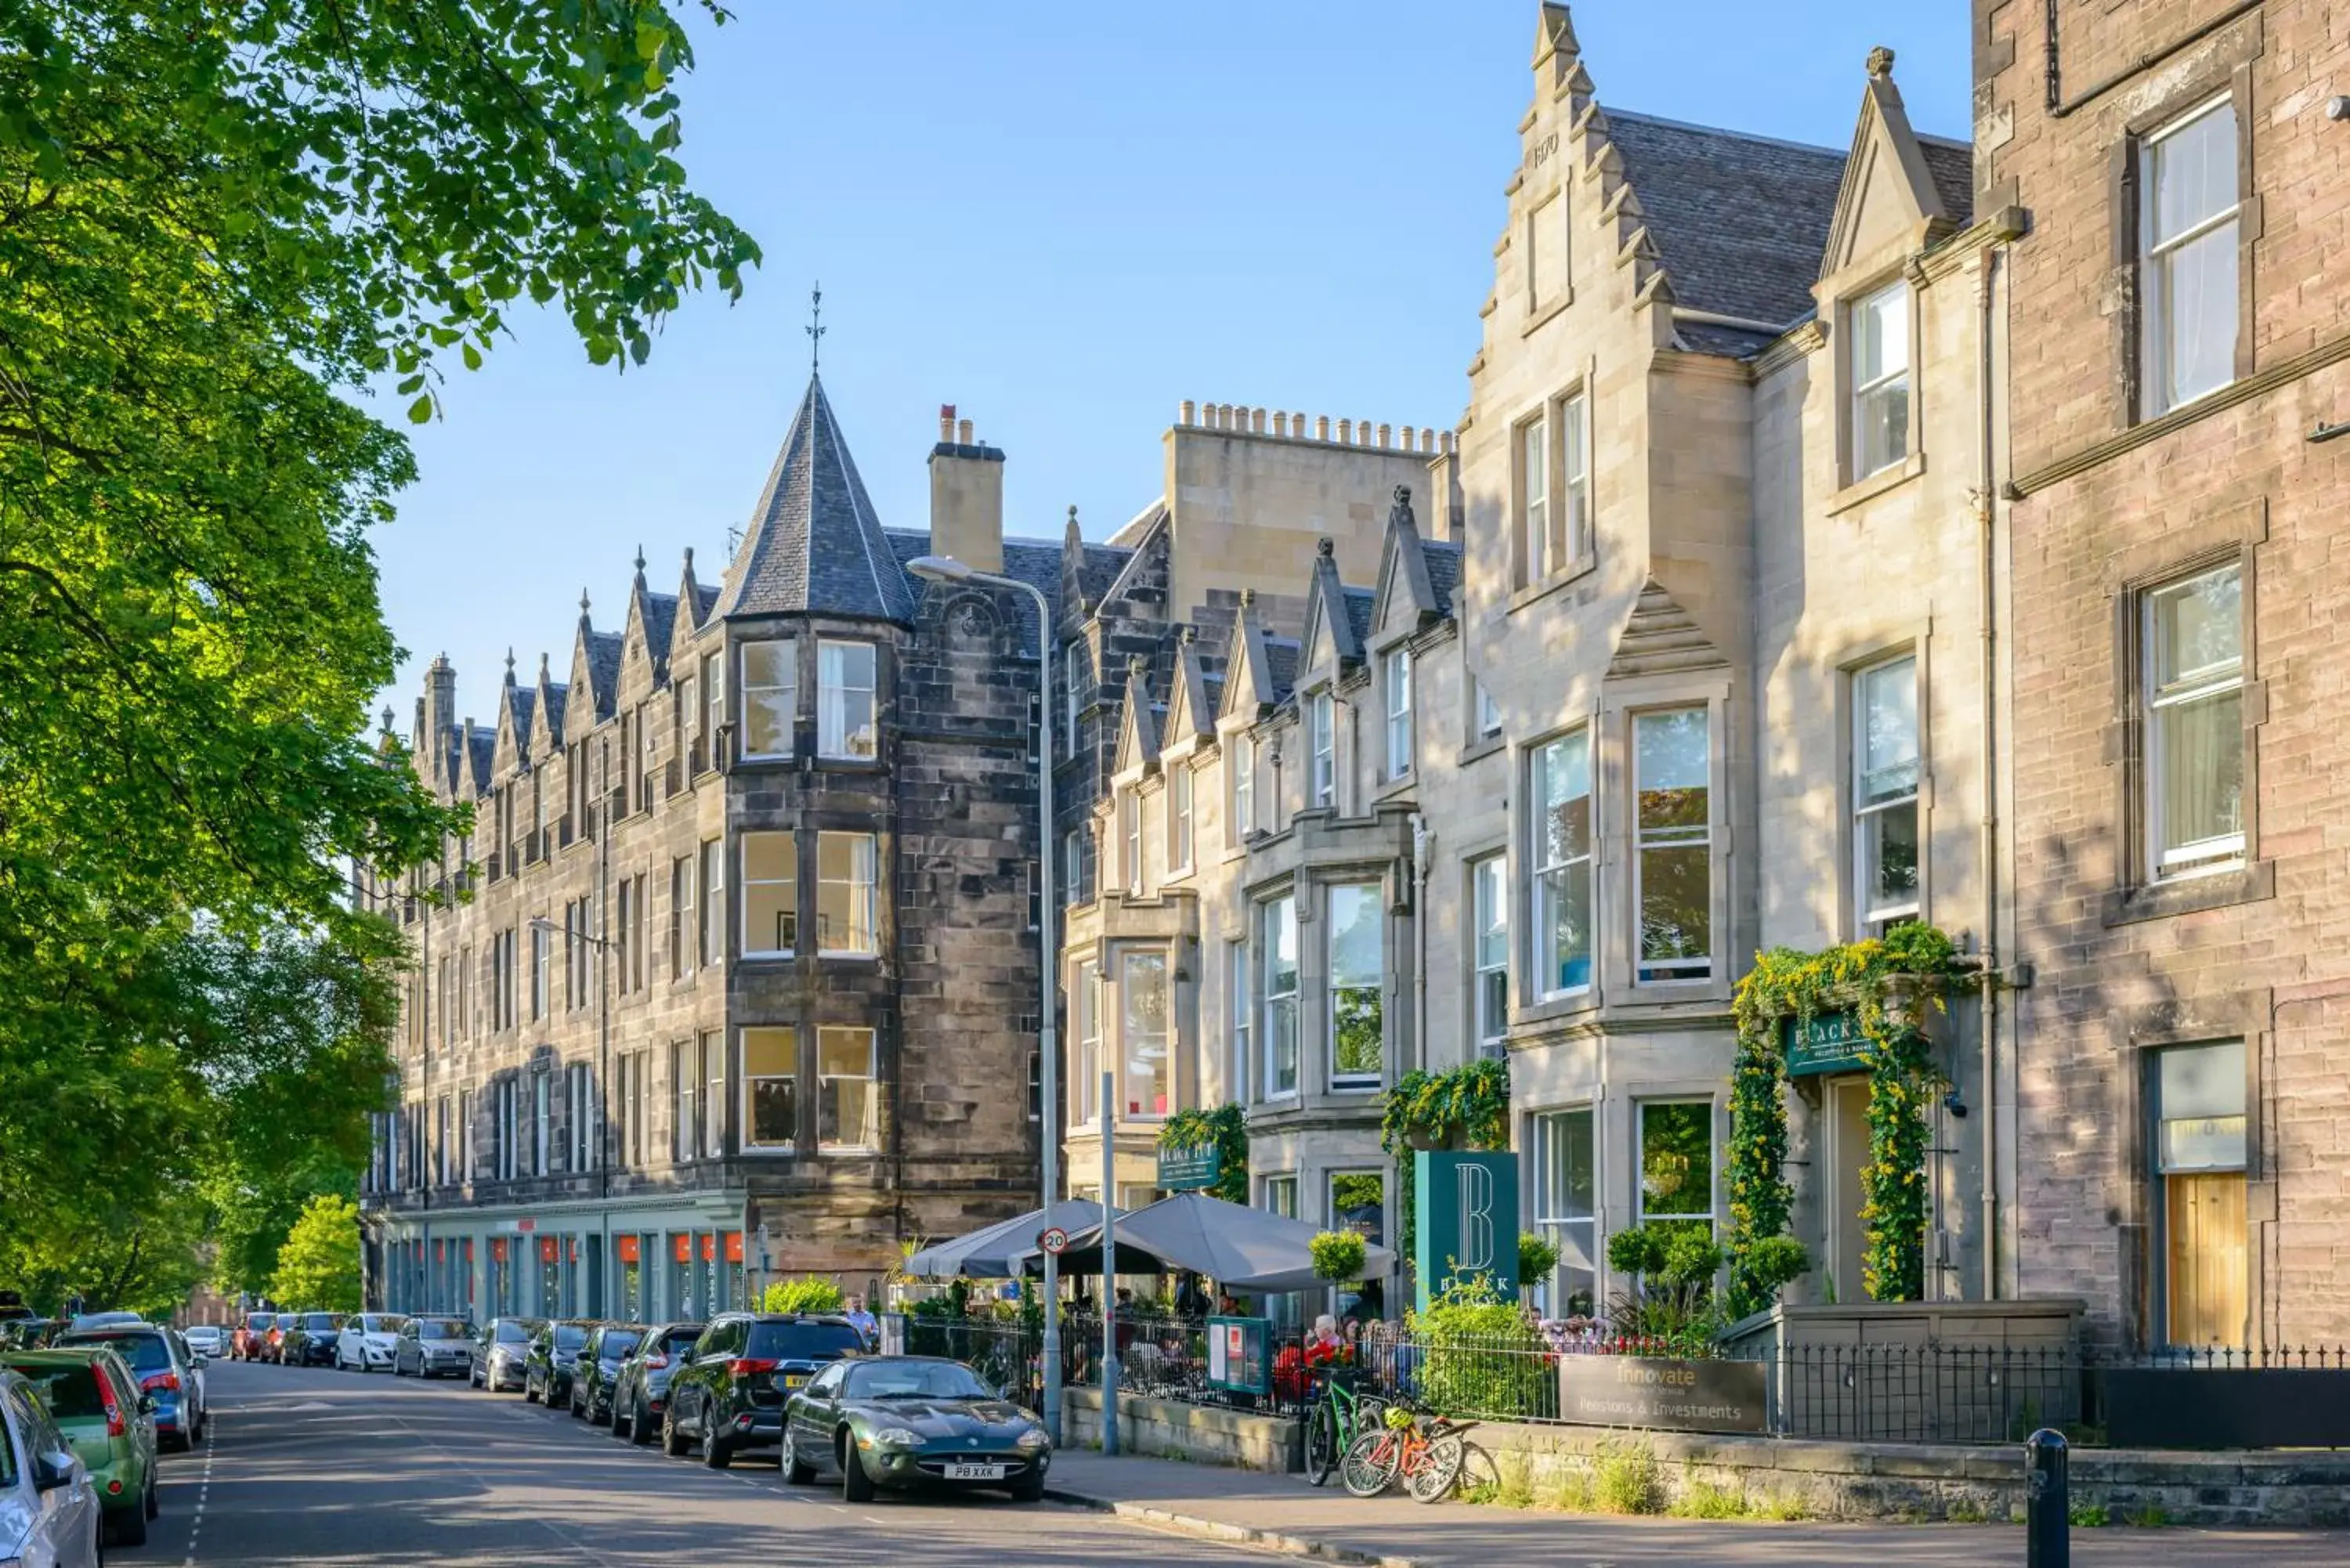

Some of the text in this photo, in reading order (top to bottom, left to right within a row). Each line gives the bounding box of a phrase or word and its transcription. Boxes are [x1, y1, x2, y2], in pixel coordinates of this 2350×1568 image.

[1455, 1163, 1493, 1270] B
[1046, 1235, 1062, 1246] 20
[1616, 1364, 1696, 1386] Innovate
[1580, 1397, 1741, 1420] Pensions & Investments
